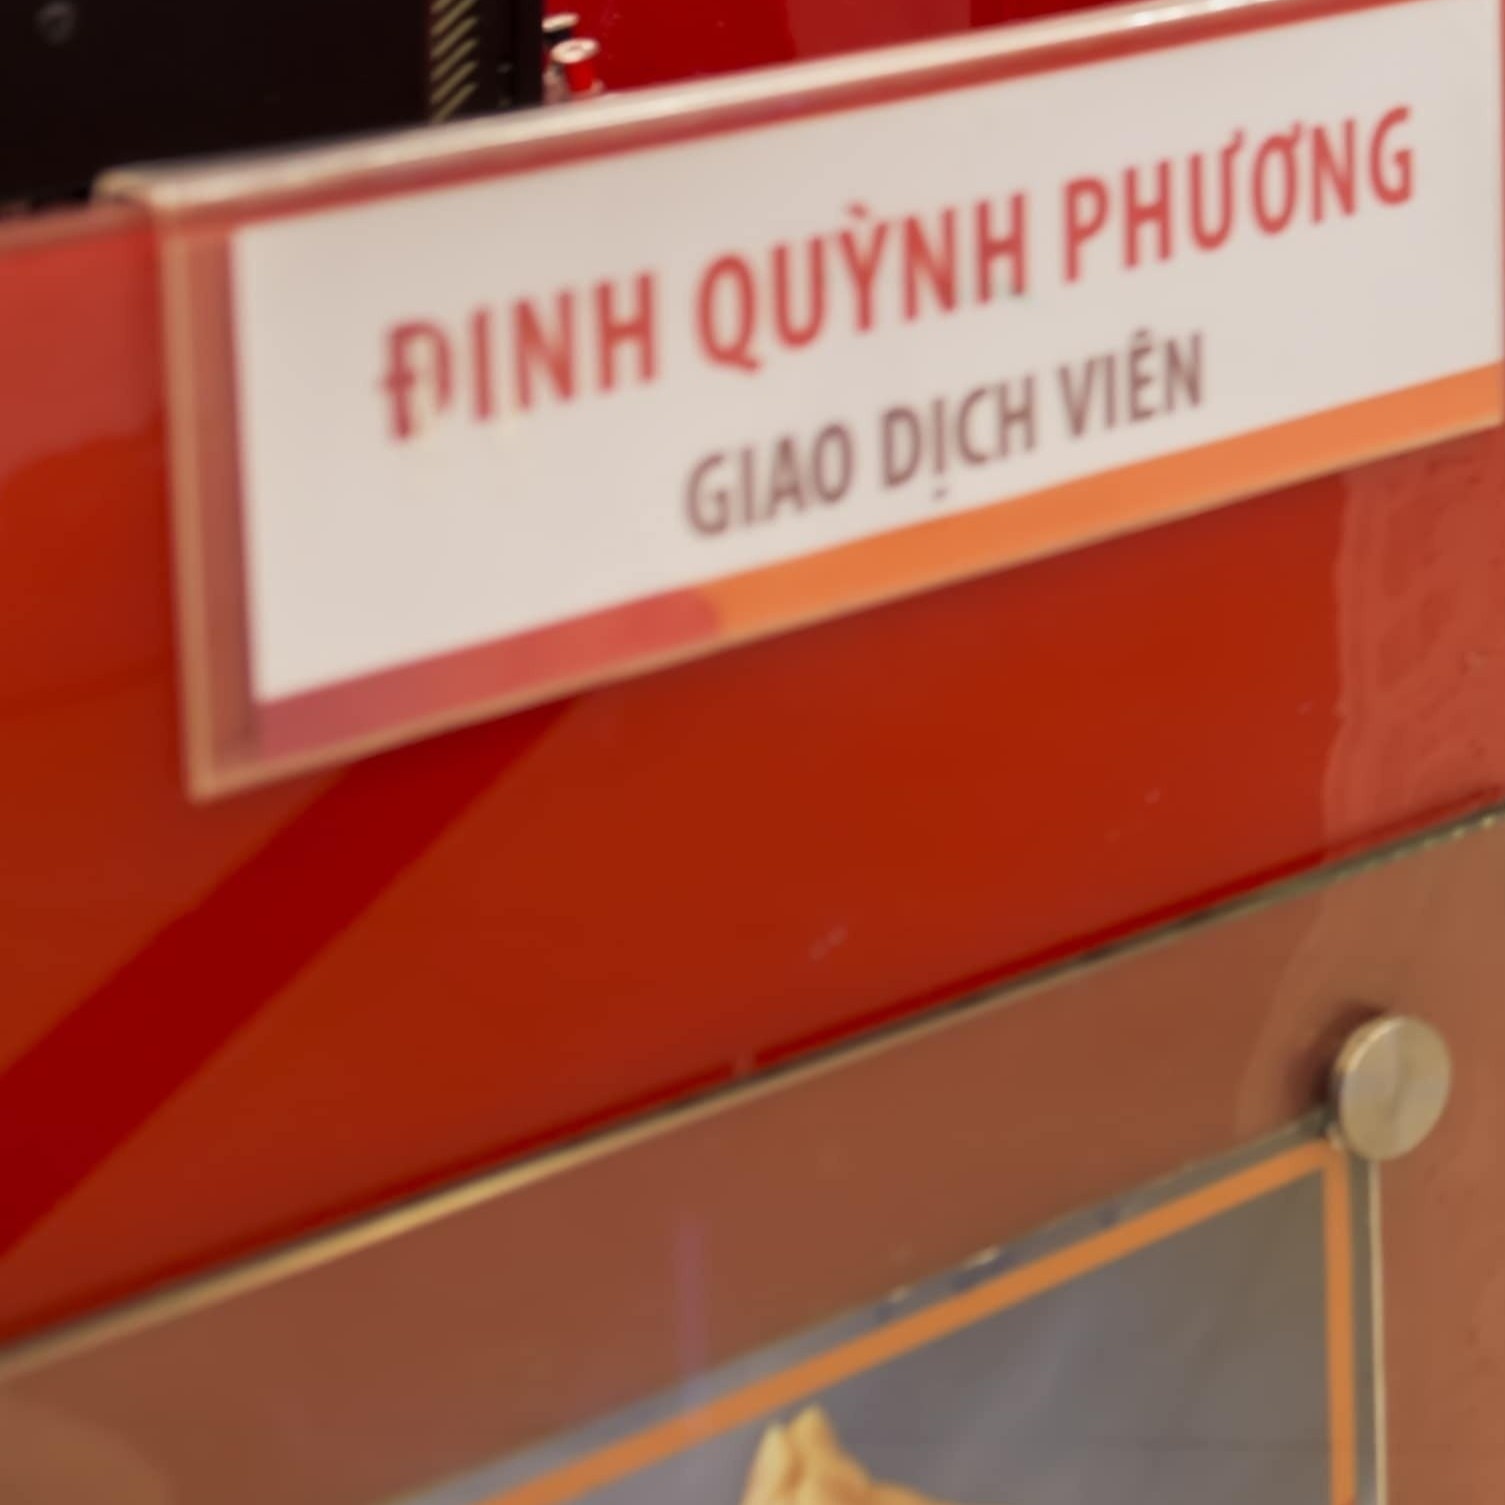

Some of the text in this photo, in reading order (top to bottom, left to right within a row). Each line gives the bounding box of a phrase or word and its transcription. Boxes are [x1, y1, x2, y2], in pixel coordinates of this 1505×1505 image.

[375, 104, 1418, 444] ĐINH QUỲNH PHƯƠNG
[683, 327, 1207, 541] GIAO DỊCH VIÊN
